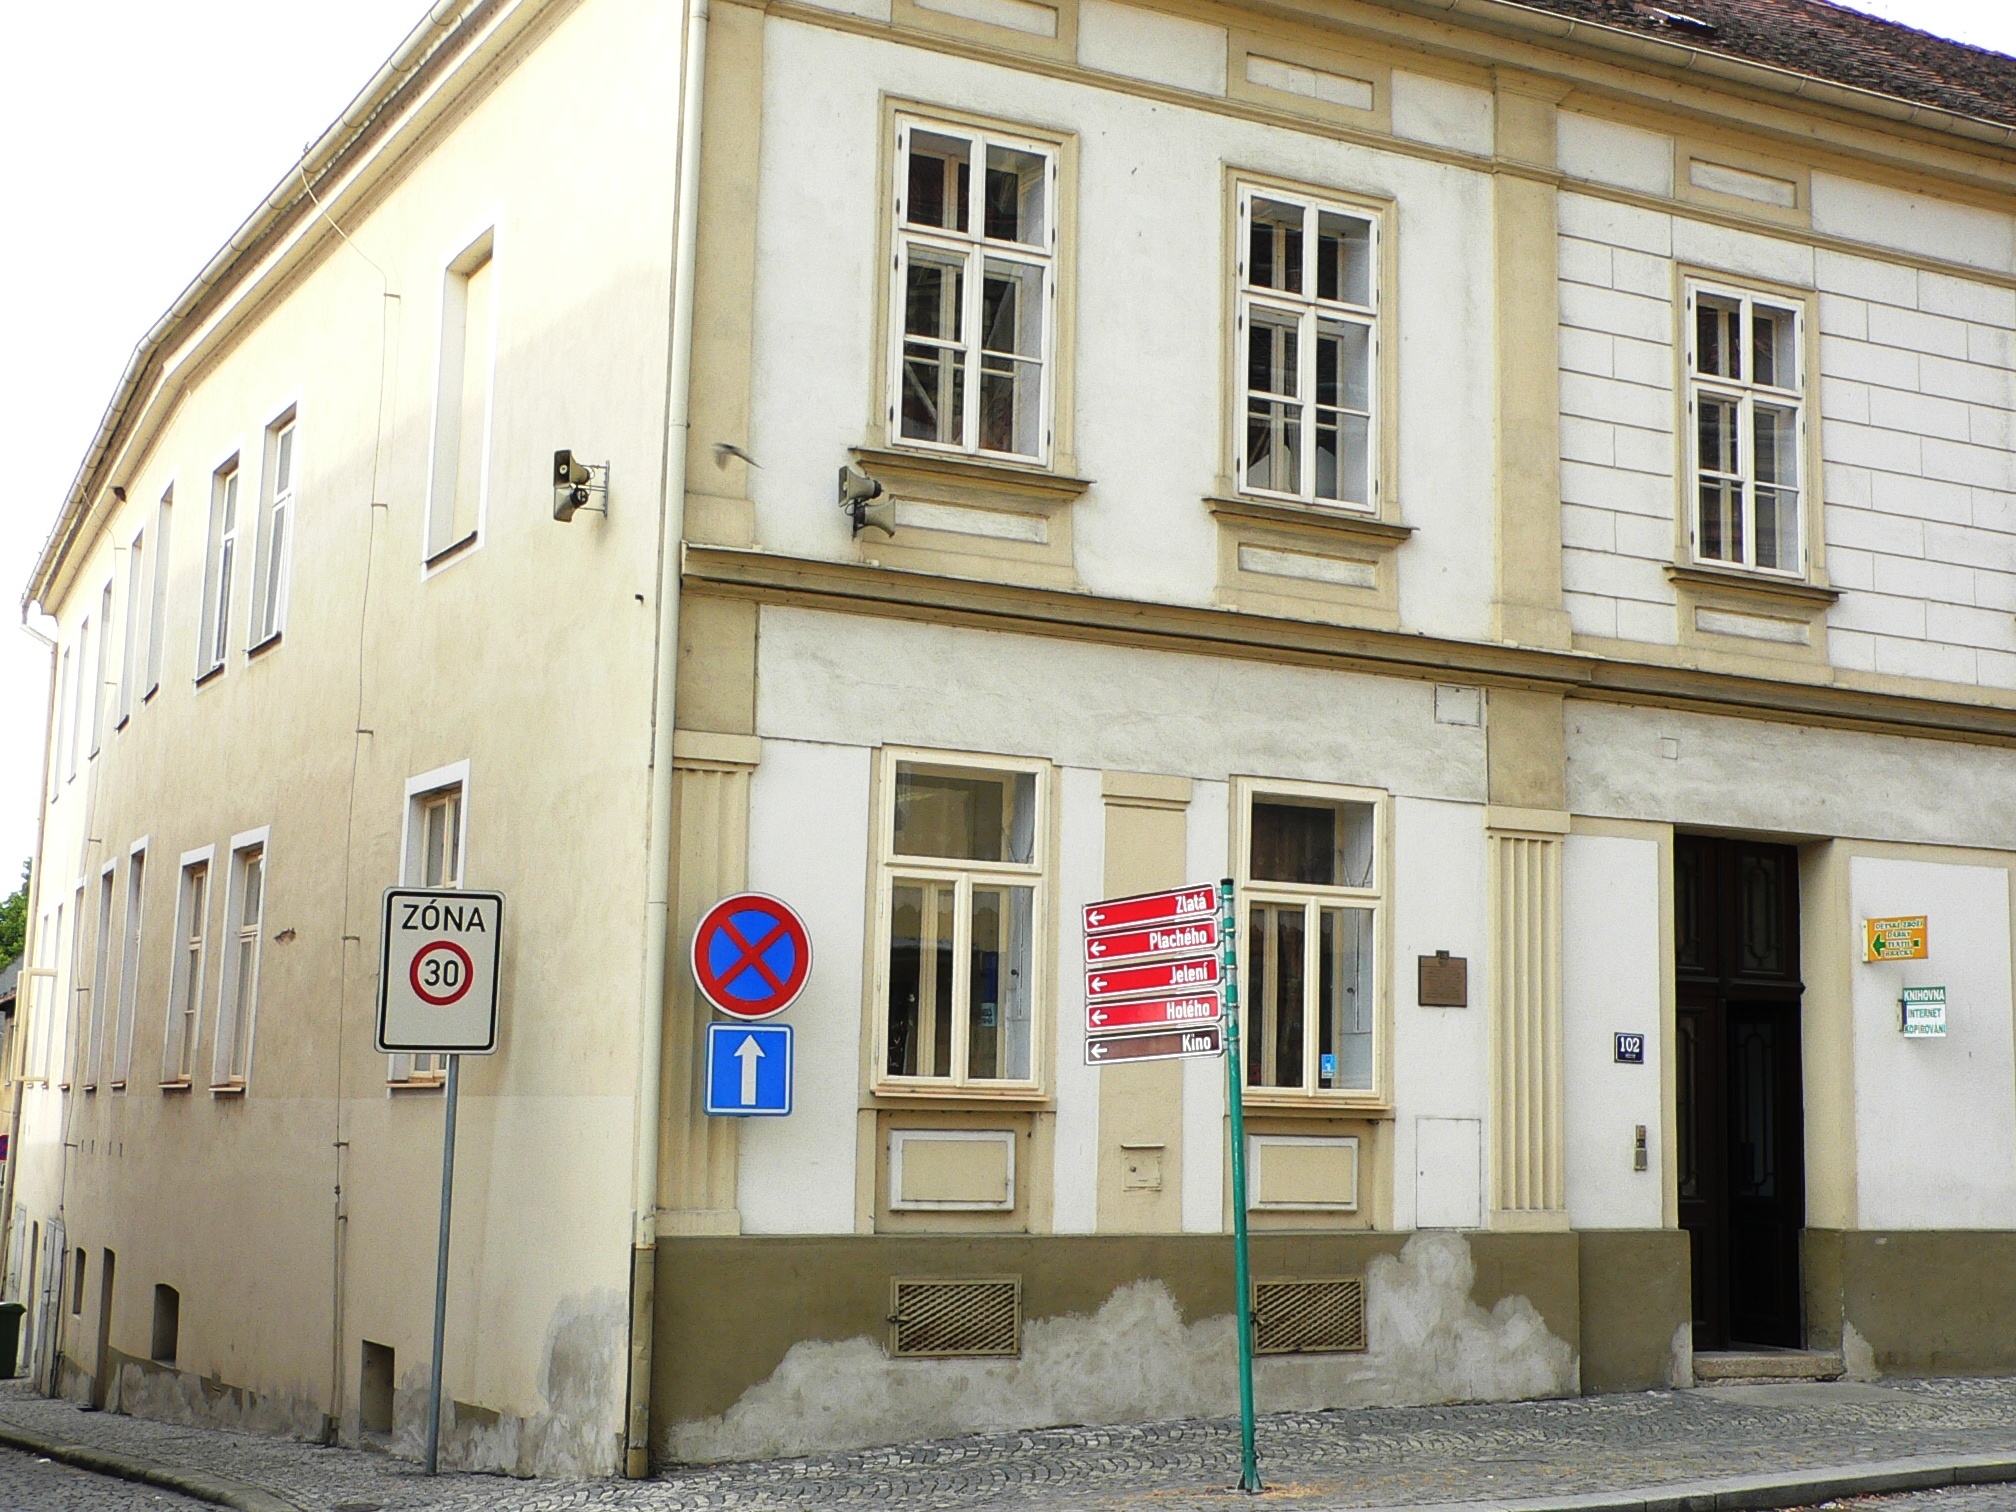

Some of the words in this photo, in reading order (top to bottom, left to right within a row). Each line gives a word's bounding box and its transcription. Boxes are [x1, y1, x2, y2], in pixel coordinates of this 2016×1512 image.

[1175, 892, 1207, 914] Zlatá
[402, 899, 486, 932] ZÓNA
[1149, 929, 1207, 950] Plachého
[424, 959, 459, 987] 30
[1169, 962, 1208, 984] Jelení
[1904, 989, 1945, 1001] KNIHOVNA
[1166, 1000, 1210, 1020] Holého
[1908, 1008, 1941, 1018] INTERNET
[1182, 1034, 1211, 1052] Kino
[1620, 1037, 1640, 1052] 102
